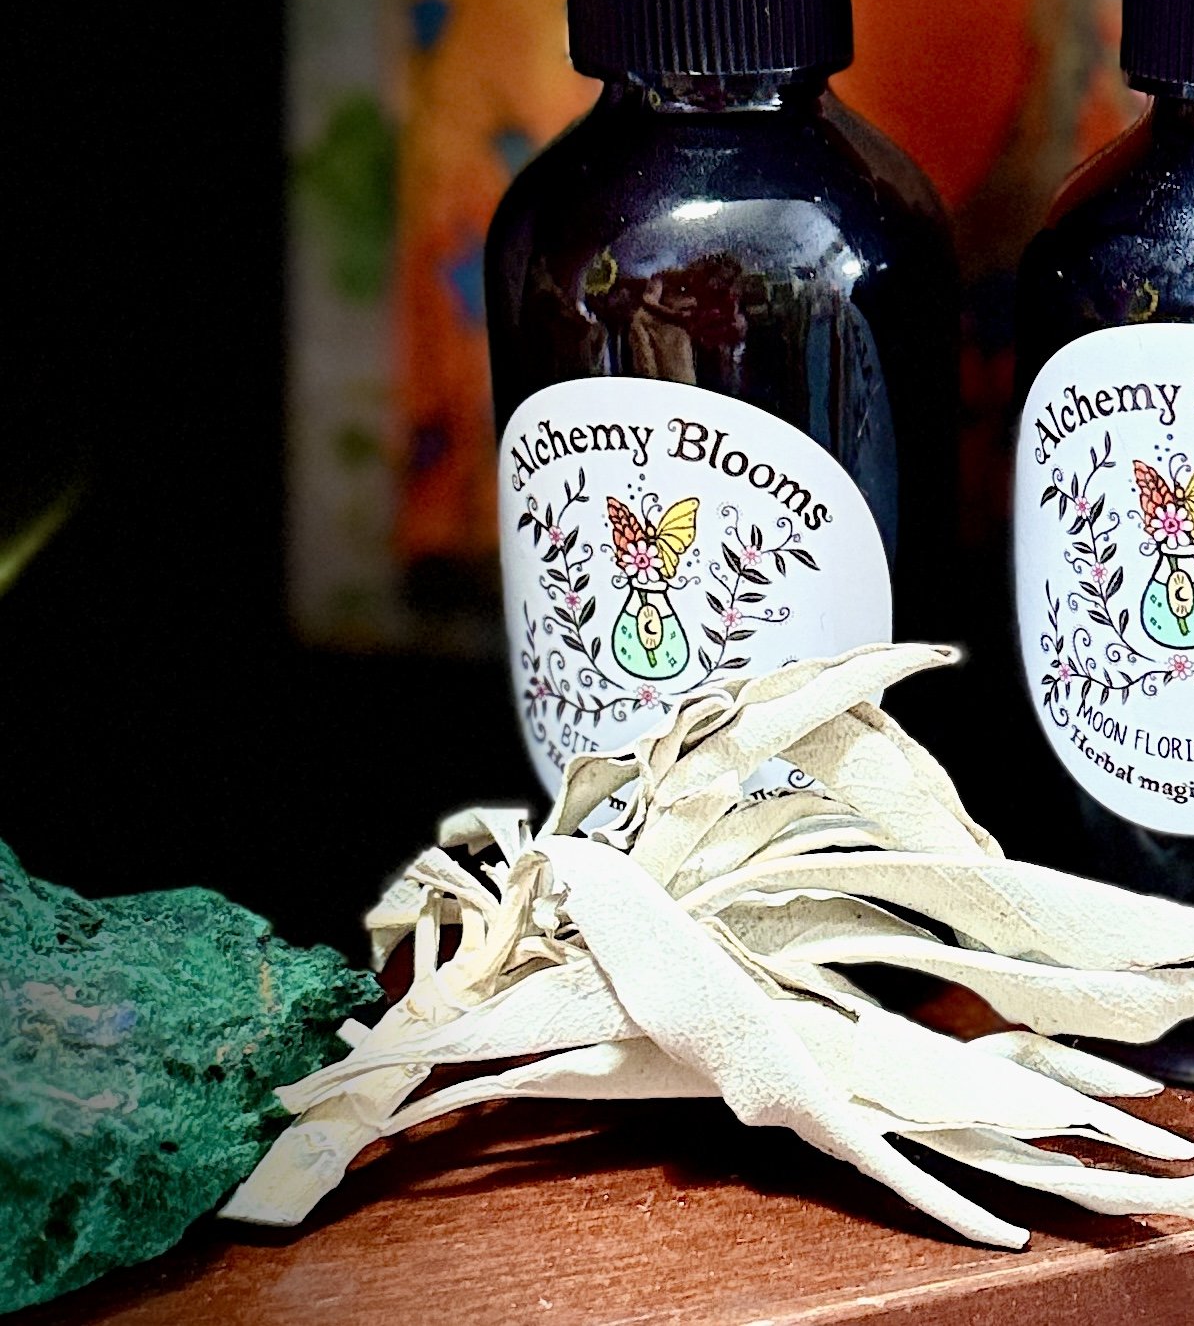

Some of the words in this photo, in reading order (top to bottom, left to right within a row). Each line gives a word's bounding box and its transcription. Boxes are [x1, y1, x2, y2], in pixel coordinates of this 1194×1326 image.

[1034, 382, 1182, 464] Alchemy
[511, 420, 654, 492] Alchemy
[667, 417, 833, 531] Blooms
[1069, 724, 1135, 784] Herbal
[1076, 699, 1128, 746] MOON
